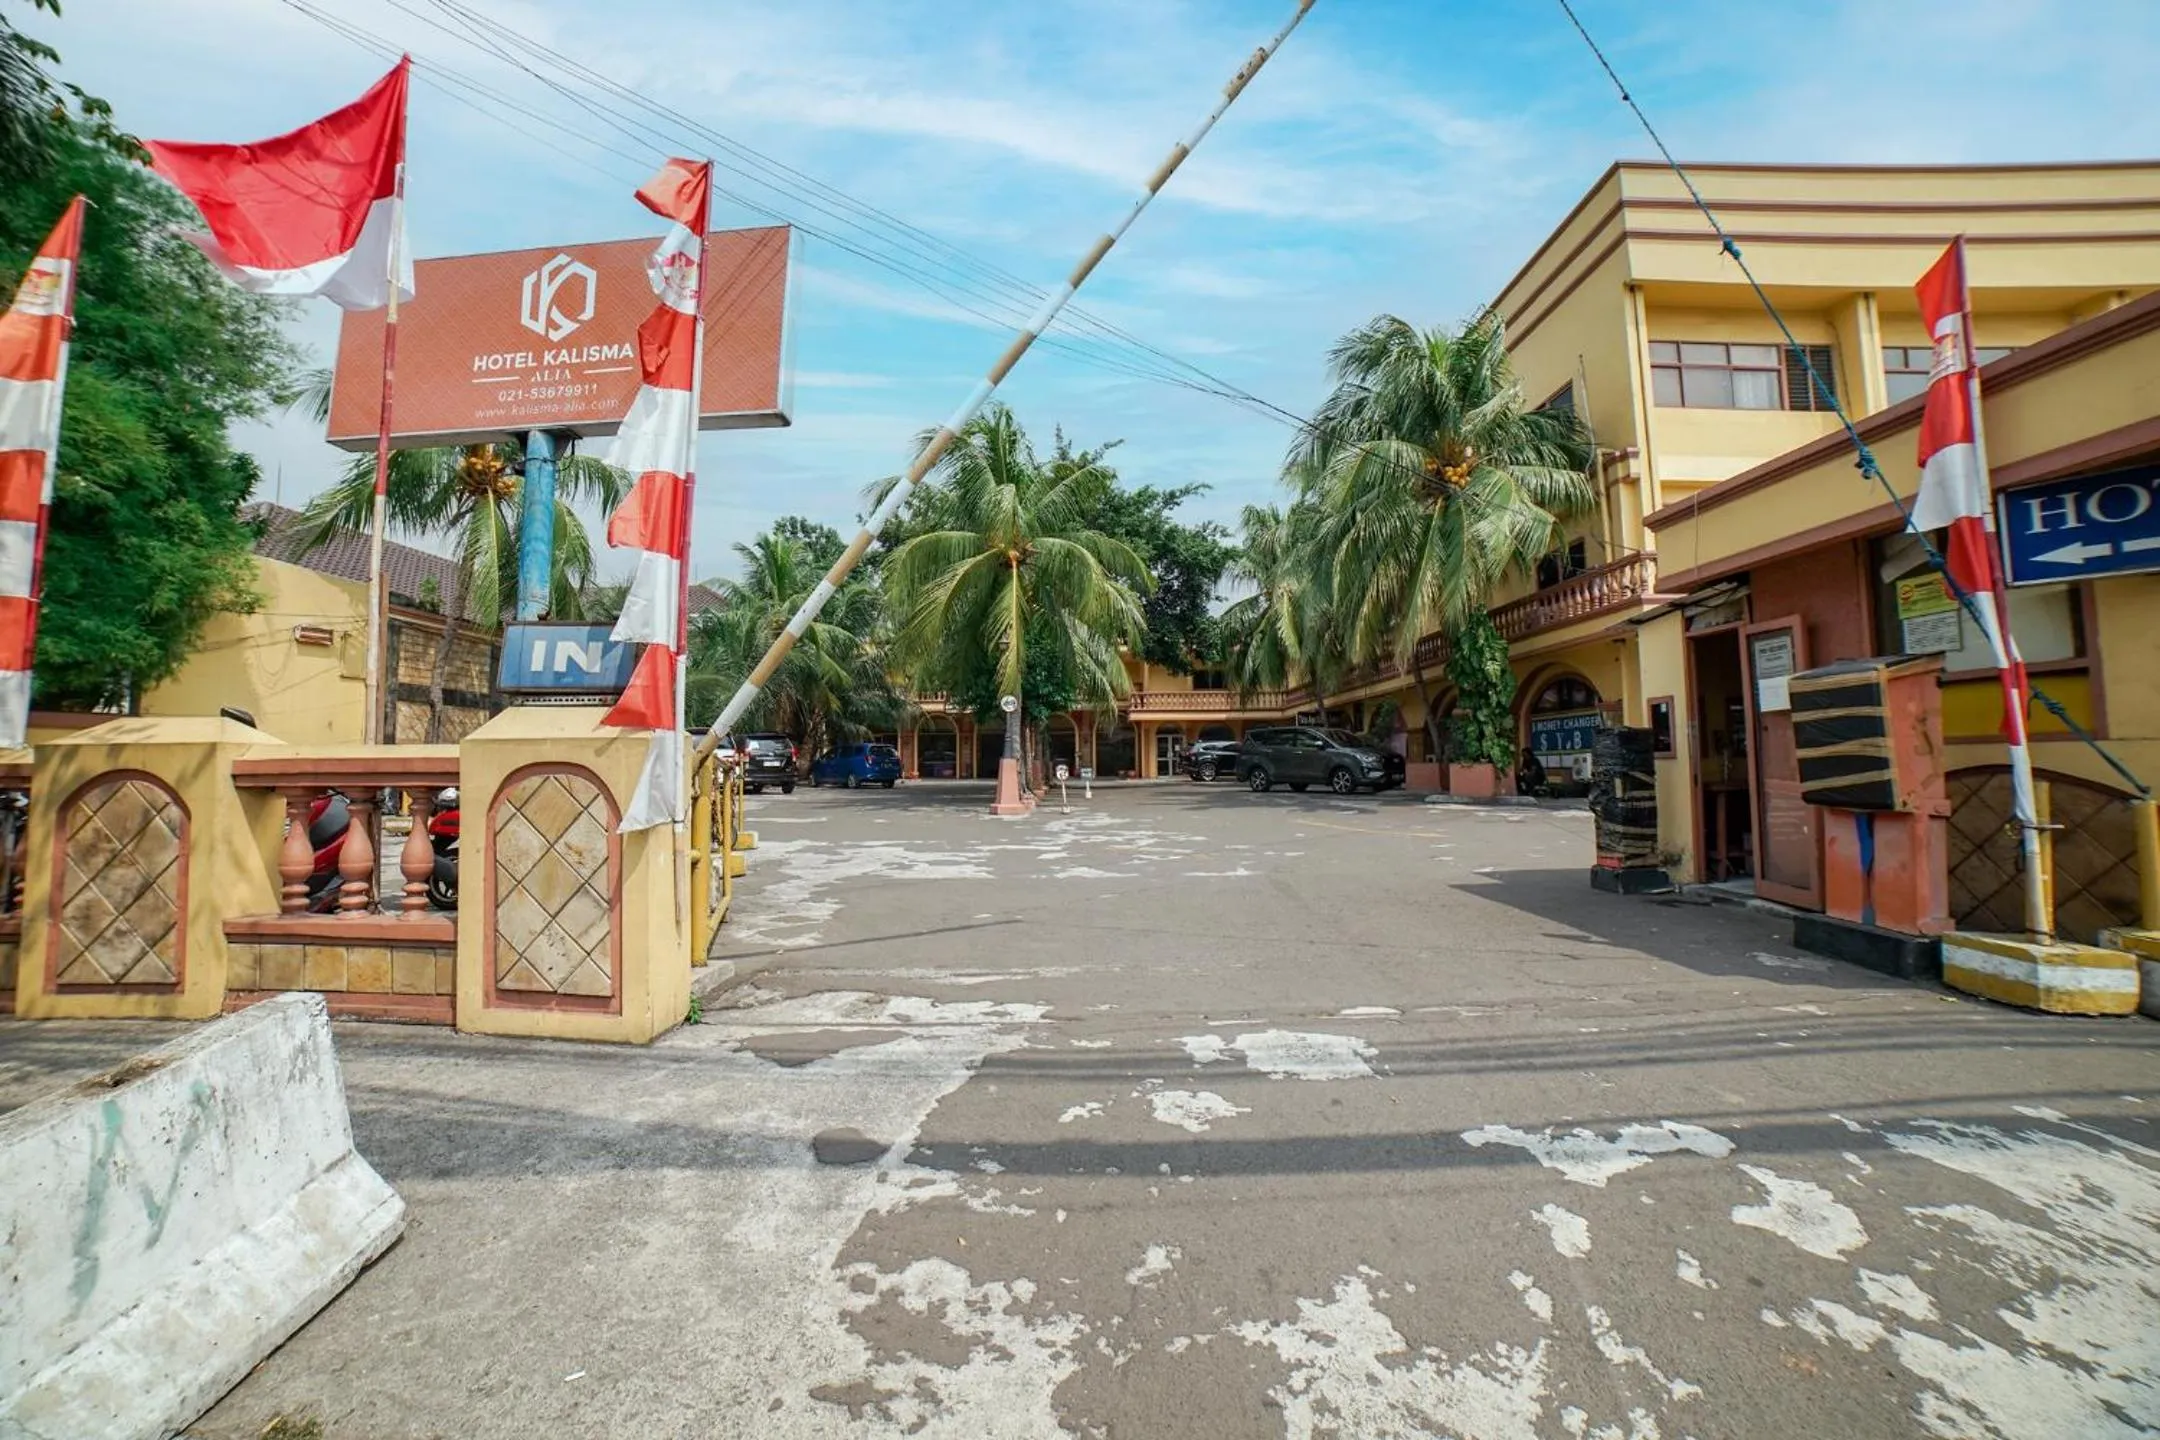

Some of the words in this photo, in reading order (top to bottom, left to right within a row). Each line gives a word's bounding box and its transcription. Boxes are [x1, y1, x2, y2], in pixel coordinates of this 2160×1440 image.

[473, 352, 538, 372] HOTEL
[543, 343, 634, 366] KALISMA
[531, 369, 572, 383] ALIA
[530, 640, 604, 673] IN
[1537, 719, 1561, 731] MONEY
